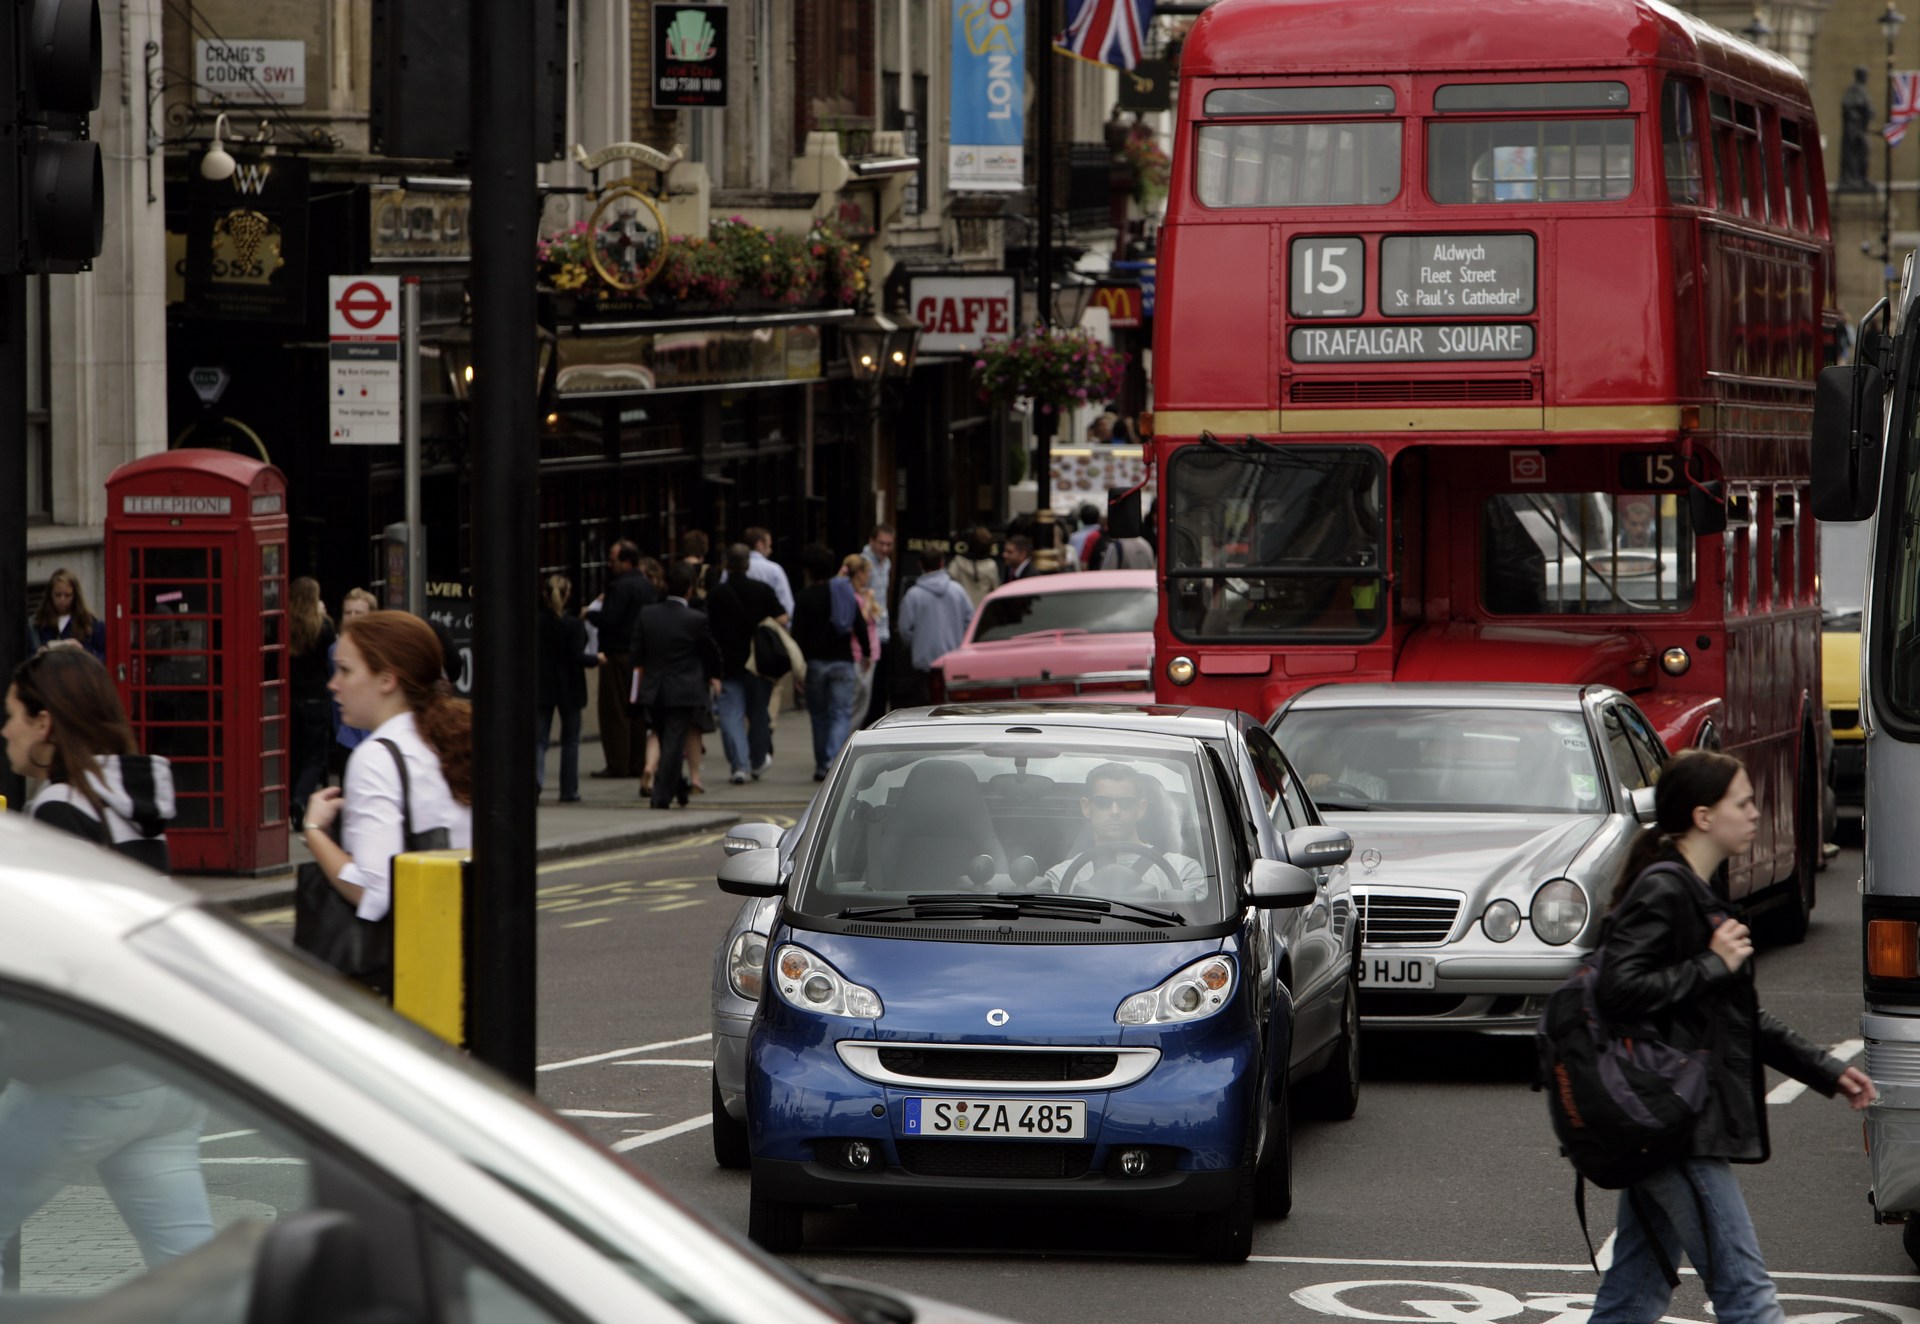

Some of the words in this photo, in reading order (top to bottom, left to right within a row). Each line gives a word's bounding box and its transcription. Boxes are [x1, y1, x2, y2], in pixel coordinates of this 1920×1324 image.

[206, 46, 265, 62] CRAIG'S
[206, 66, 256, 82] COURT
[263, 66, 294, 82] SW1
[1433, 243, 1485, 265] Aldwych
[1303, 246, 1348, 295] 15
[1420, 266, 1452, 284] Fleet
[1459, 265, 1497, 283] Street
[1395, 289, 1409, 307] St
[1416, 288, 1455, 306] Paul's
[1462, 287, 1521, 306] Cathedral
[917, 295, 1008, 334] CAFE
[1302, 329, 1425, 355] TRAFALGAR
[1438, 326, 1522, 353] SQUARE
[1646, 454, 1675, 484] 15
[131, 497, 226, 512] TELEPHONE
[1374, 960, 1422, 982] HJO
[909, 1120, 917, 1129] D
[933, 1103, 952, 1131] S
[973, 1104, 1010, 1132] ZA
[1018, 1105, 1073, 1134] 485
